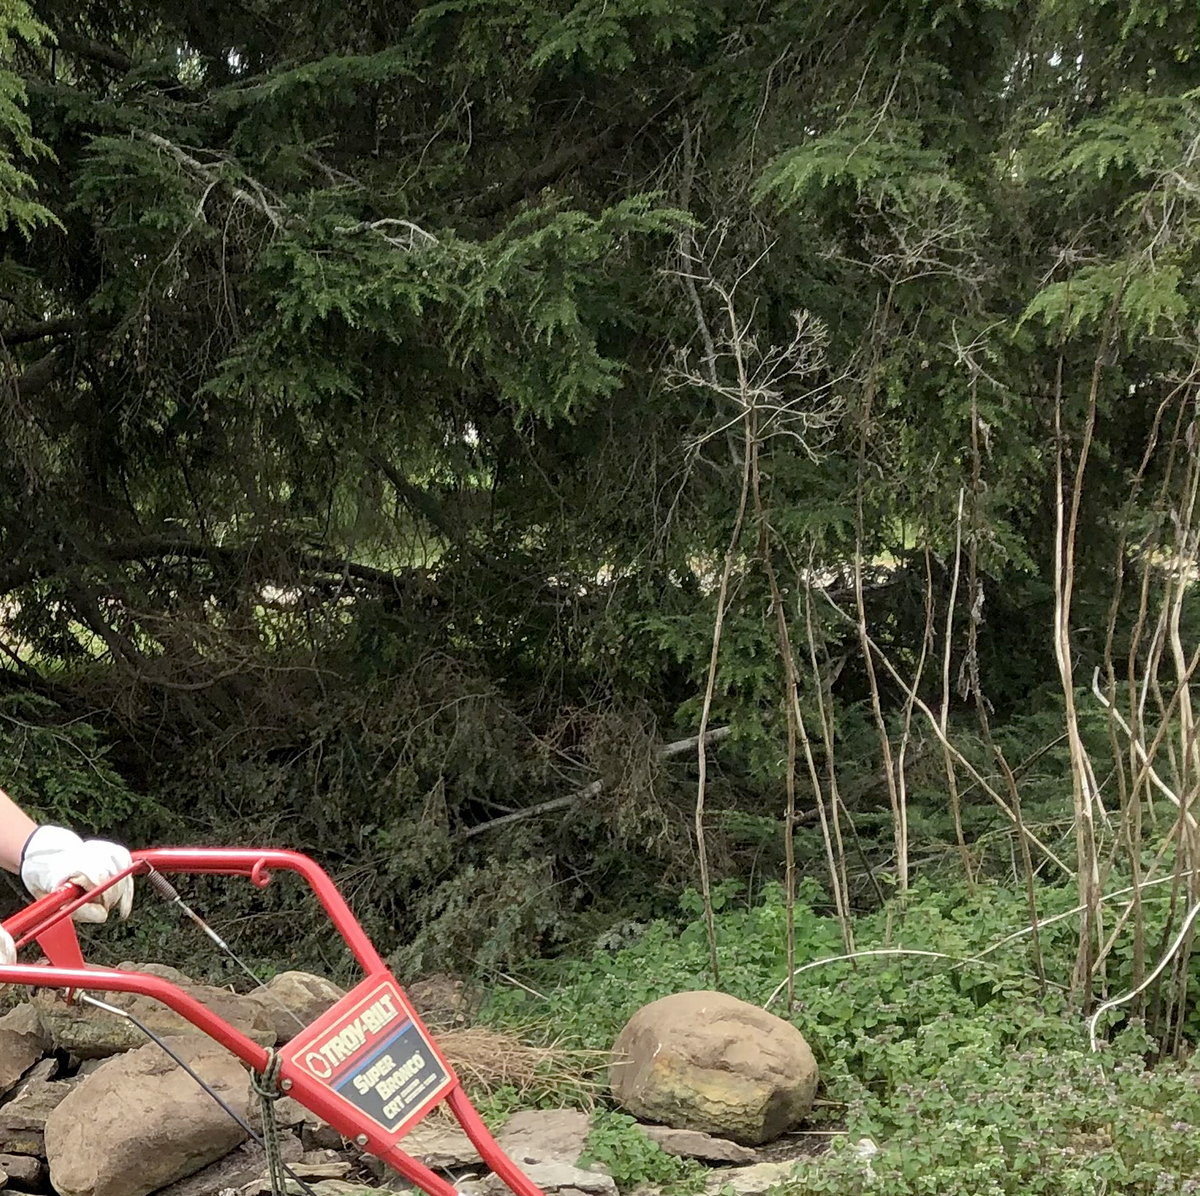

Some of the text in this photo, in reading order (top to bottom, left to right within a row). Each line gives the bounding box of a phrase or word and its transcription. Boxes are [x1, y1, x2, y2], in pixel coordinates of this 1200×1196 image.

[319, 993, 399, 1067] TROY-BILT
[353, 1054, 397, 1096] SUPER
[374, 1053, 426, 1101] BRONCO
